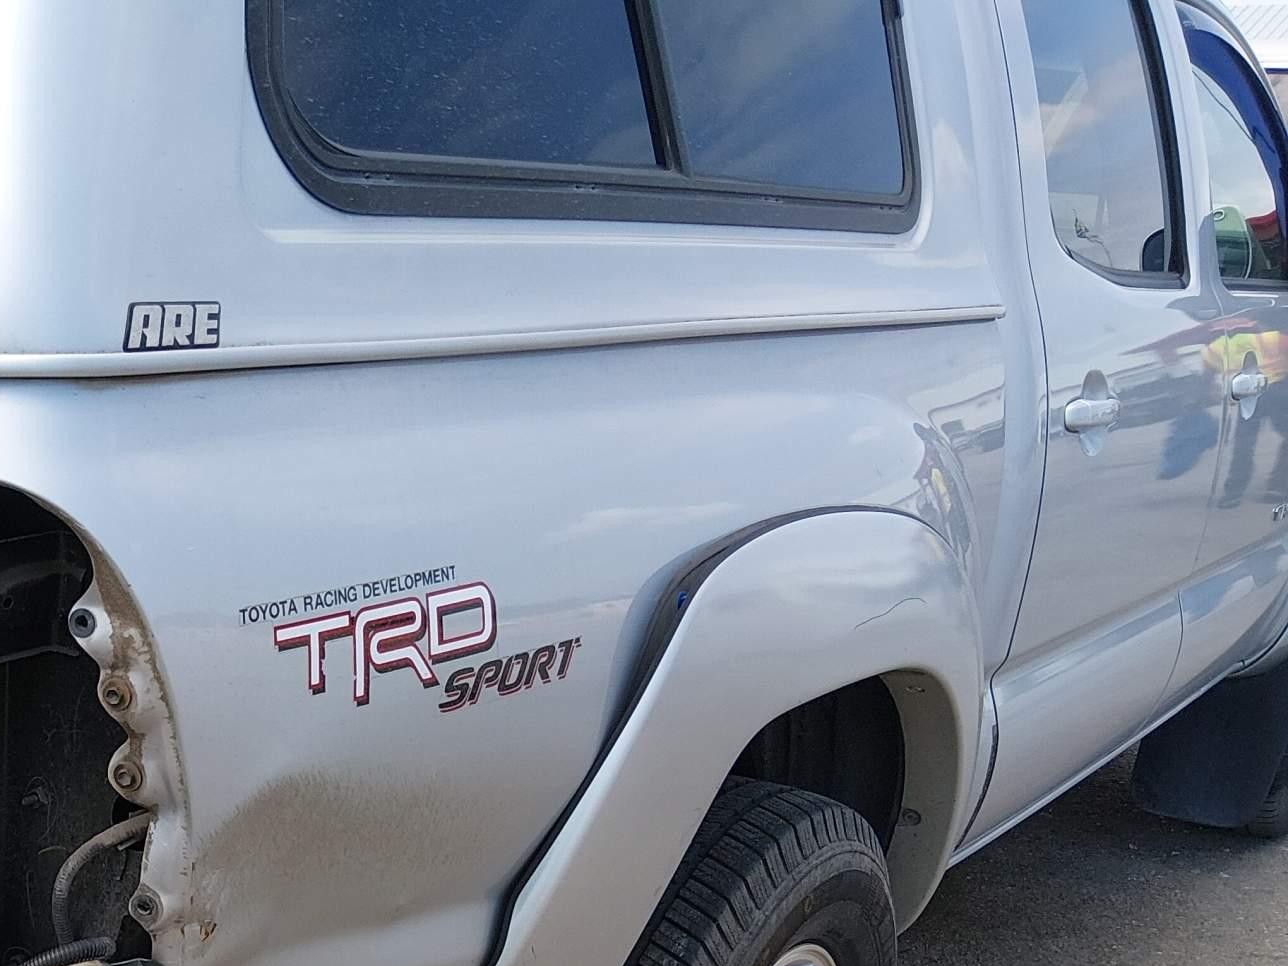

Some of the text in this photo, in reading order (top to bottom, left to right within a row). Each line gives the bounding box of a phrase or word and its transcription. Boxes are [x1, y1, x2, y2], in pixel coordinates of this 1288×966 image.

[126, 303, 220, 349] ARE
[239, 565, 456, 625] TOYOTA RACING DEVELOPMENT
[274, 581, 498, 707] TRD
[438, 636, 582, 713] SPORT
